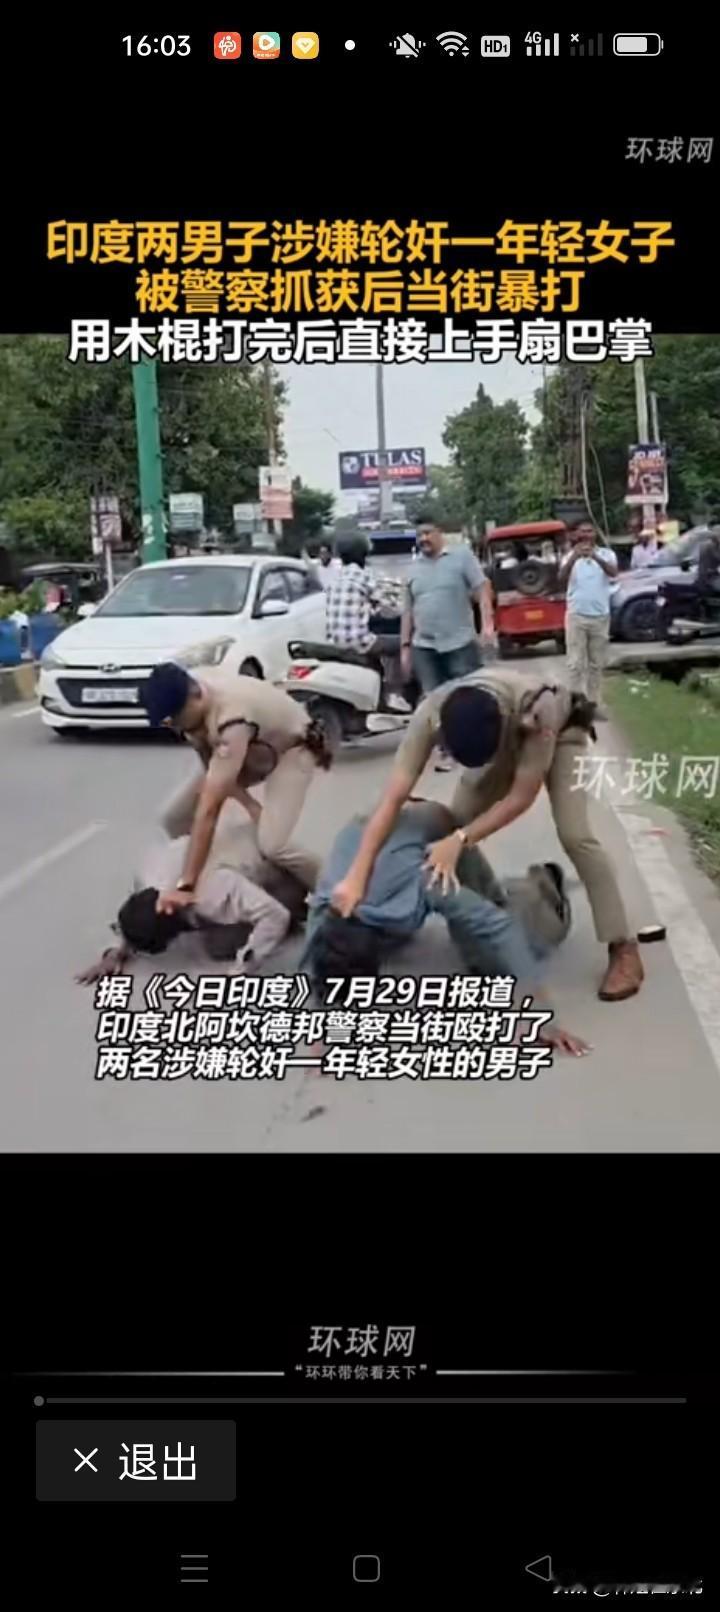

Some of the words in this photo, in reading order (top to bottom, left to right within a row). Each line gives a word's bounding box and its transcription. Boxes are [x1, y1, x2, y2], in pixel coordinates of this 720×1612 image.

[122, 35, 191, 57] 16:03
[524, 31, 542, 44] 4G
[118, 1441, 197, 1481] 退出
